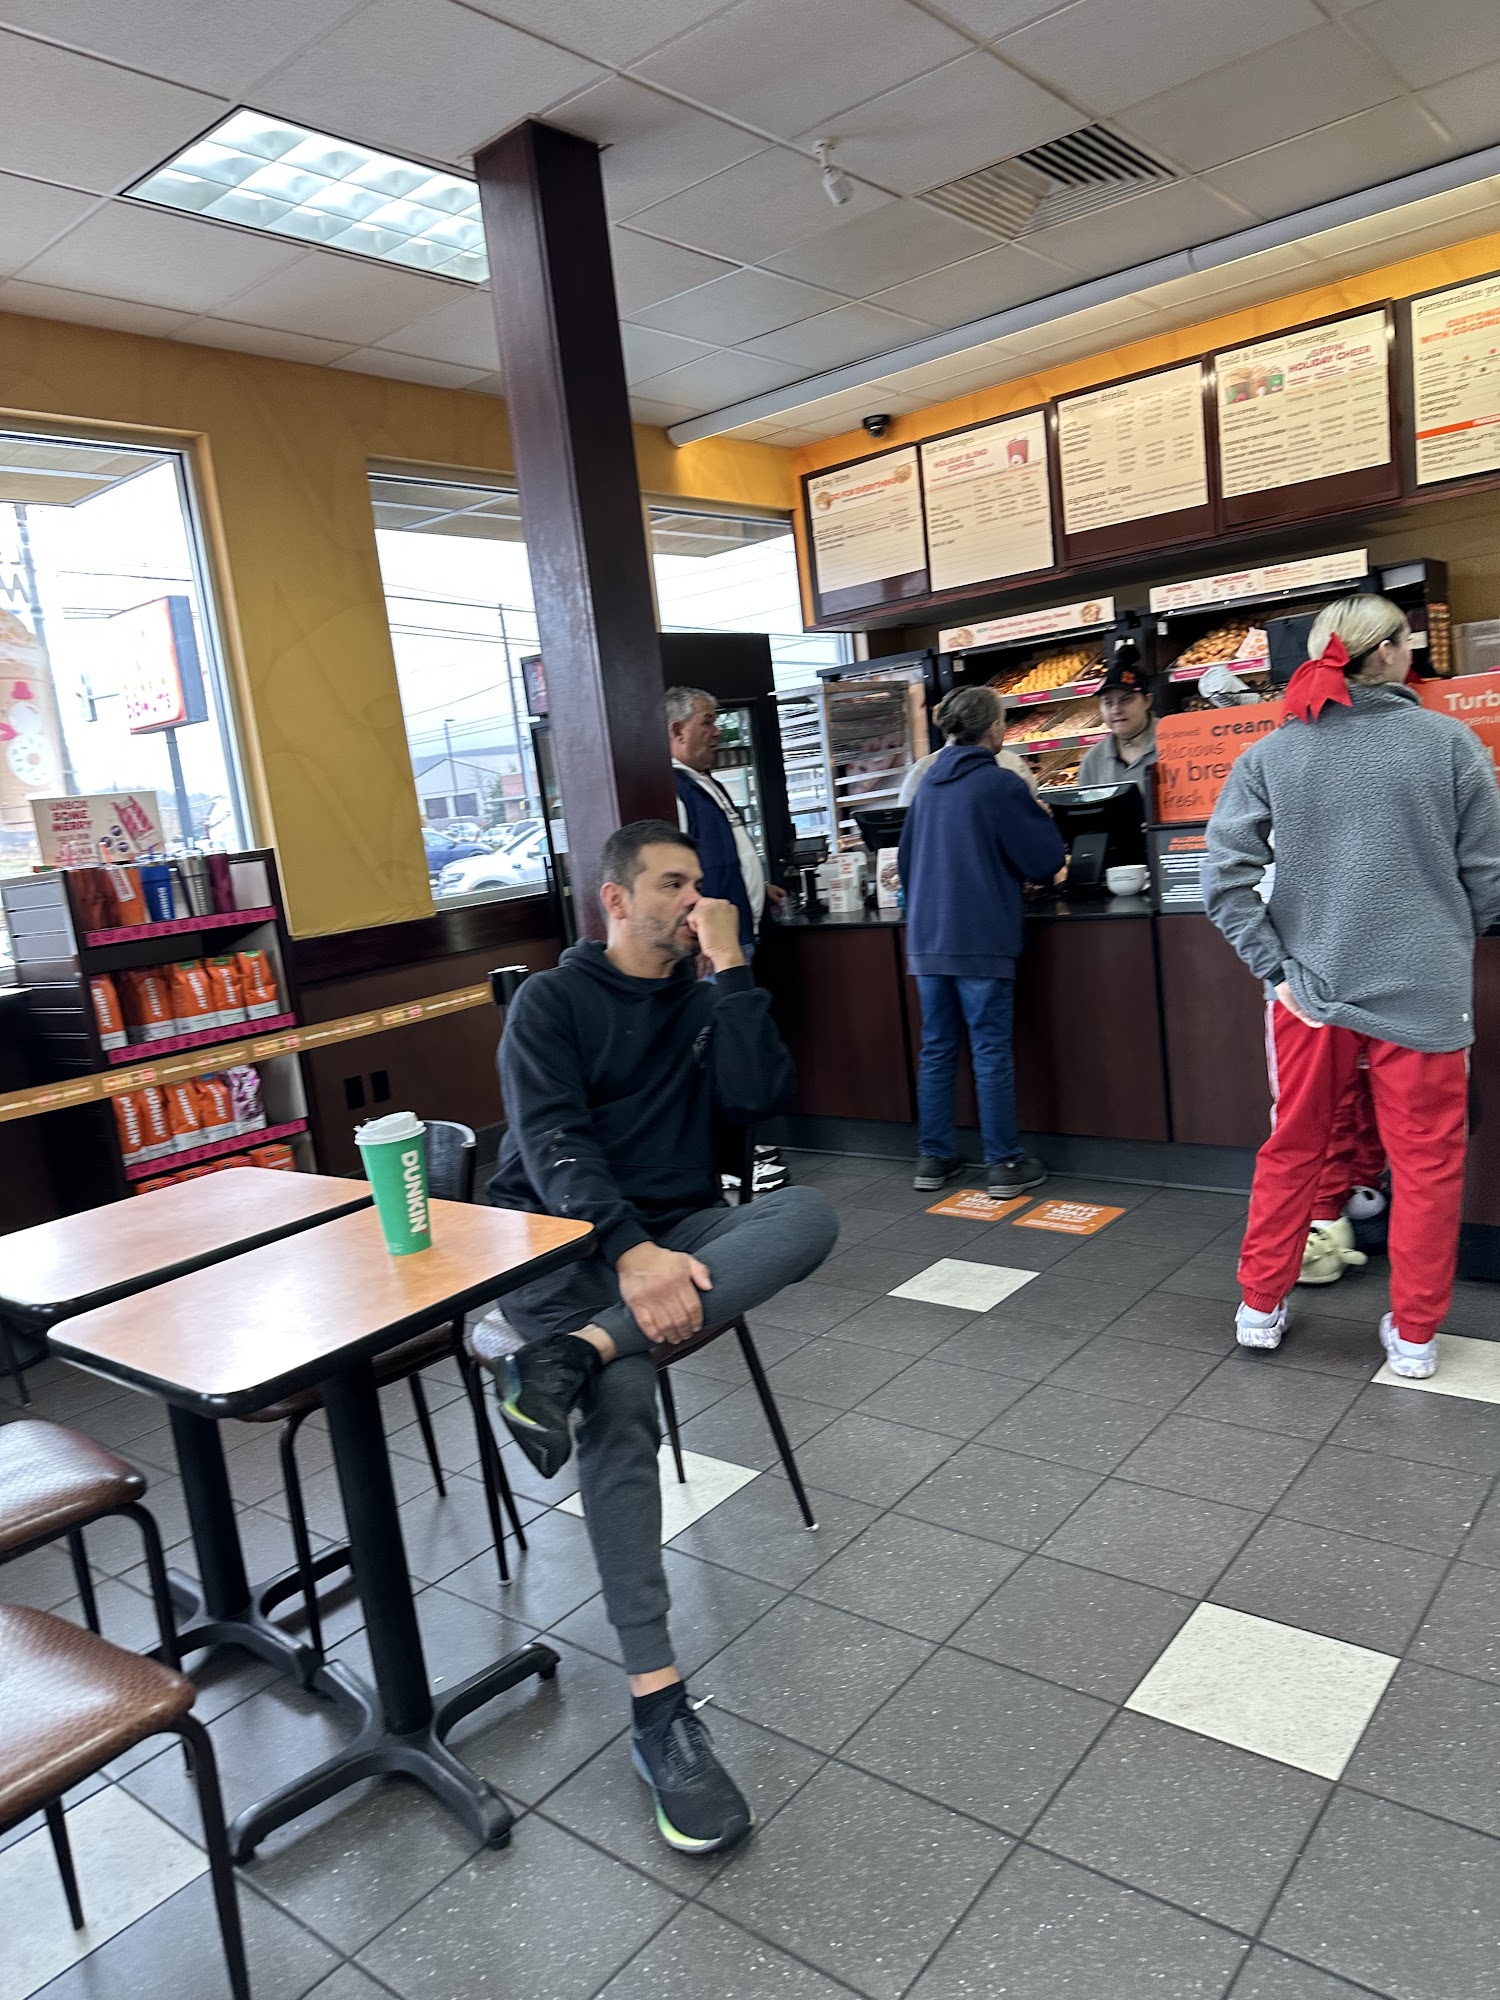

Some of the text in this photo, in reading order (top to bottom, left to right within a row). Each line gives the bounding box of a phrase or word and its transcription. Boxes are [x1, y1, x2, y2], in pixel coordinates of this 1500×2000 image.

[1416, 286, 1481, 316] personalize
[1286, 327, 1339, 351] beverages
[1287, 354, 1333, 372] HOLIDAY
[1061, 387, 1128, 414] espresso drinks
[1066, 489, 1106, 506] signature
[1106, 482, 1132, 495] lattes
[1443, 689, 1500, 712] Turb
[1210, 718, 1276, 738] cream
[1158, 740, 1226, 762] elicious
[48, 799, 91, 811] UNBOX
[52, 810, 90, 822] SOME
[52, 820, 95, 833] MERRY
[1051, 1208, 1100, 1218] WAIT
